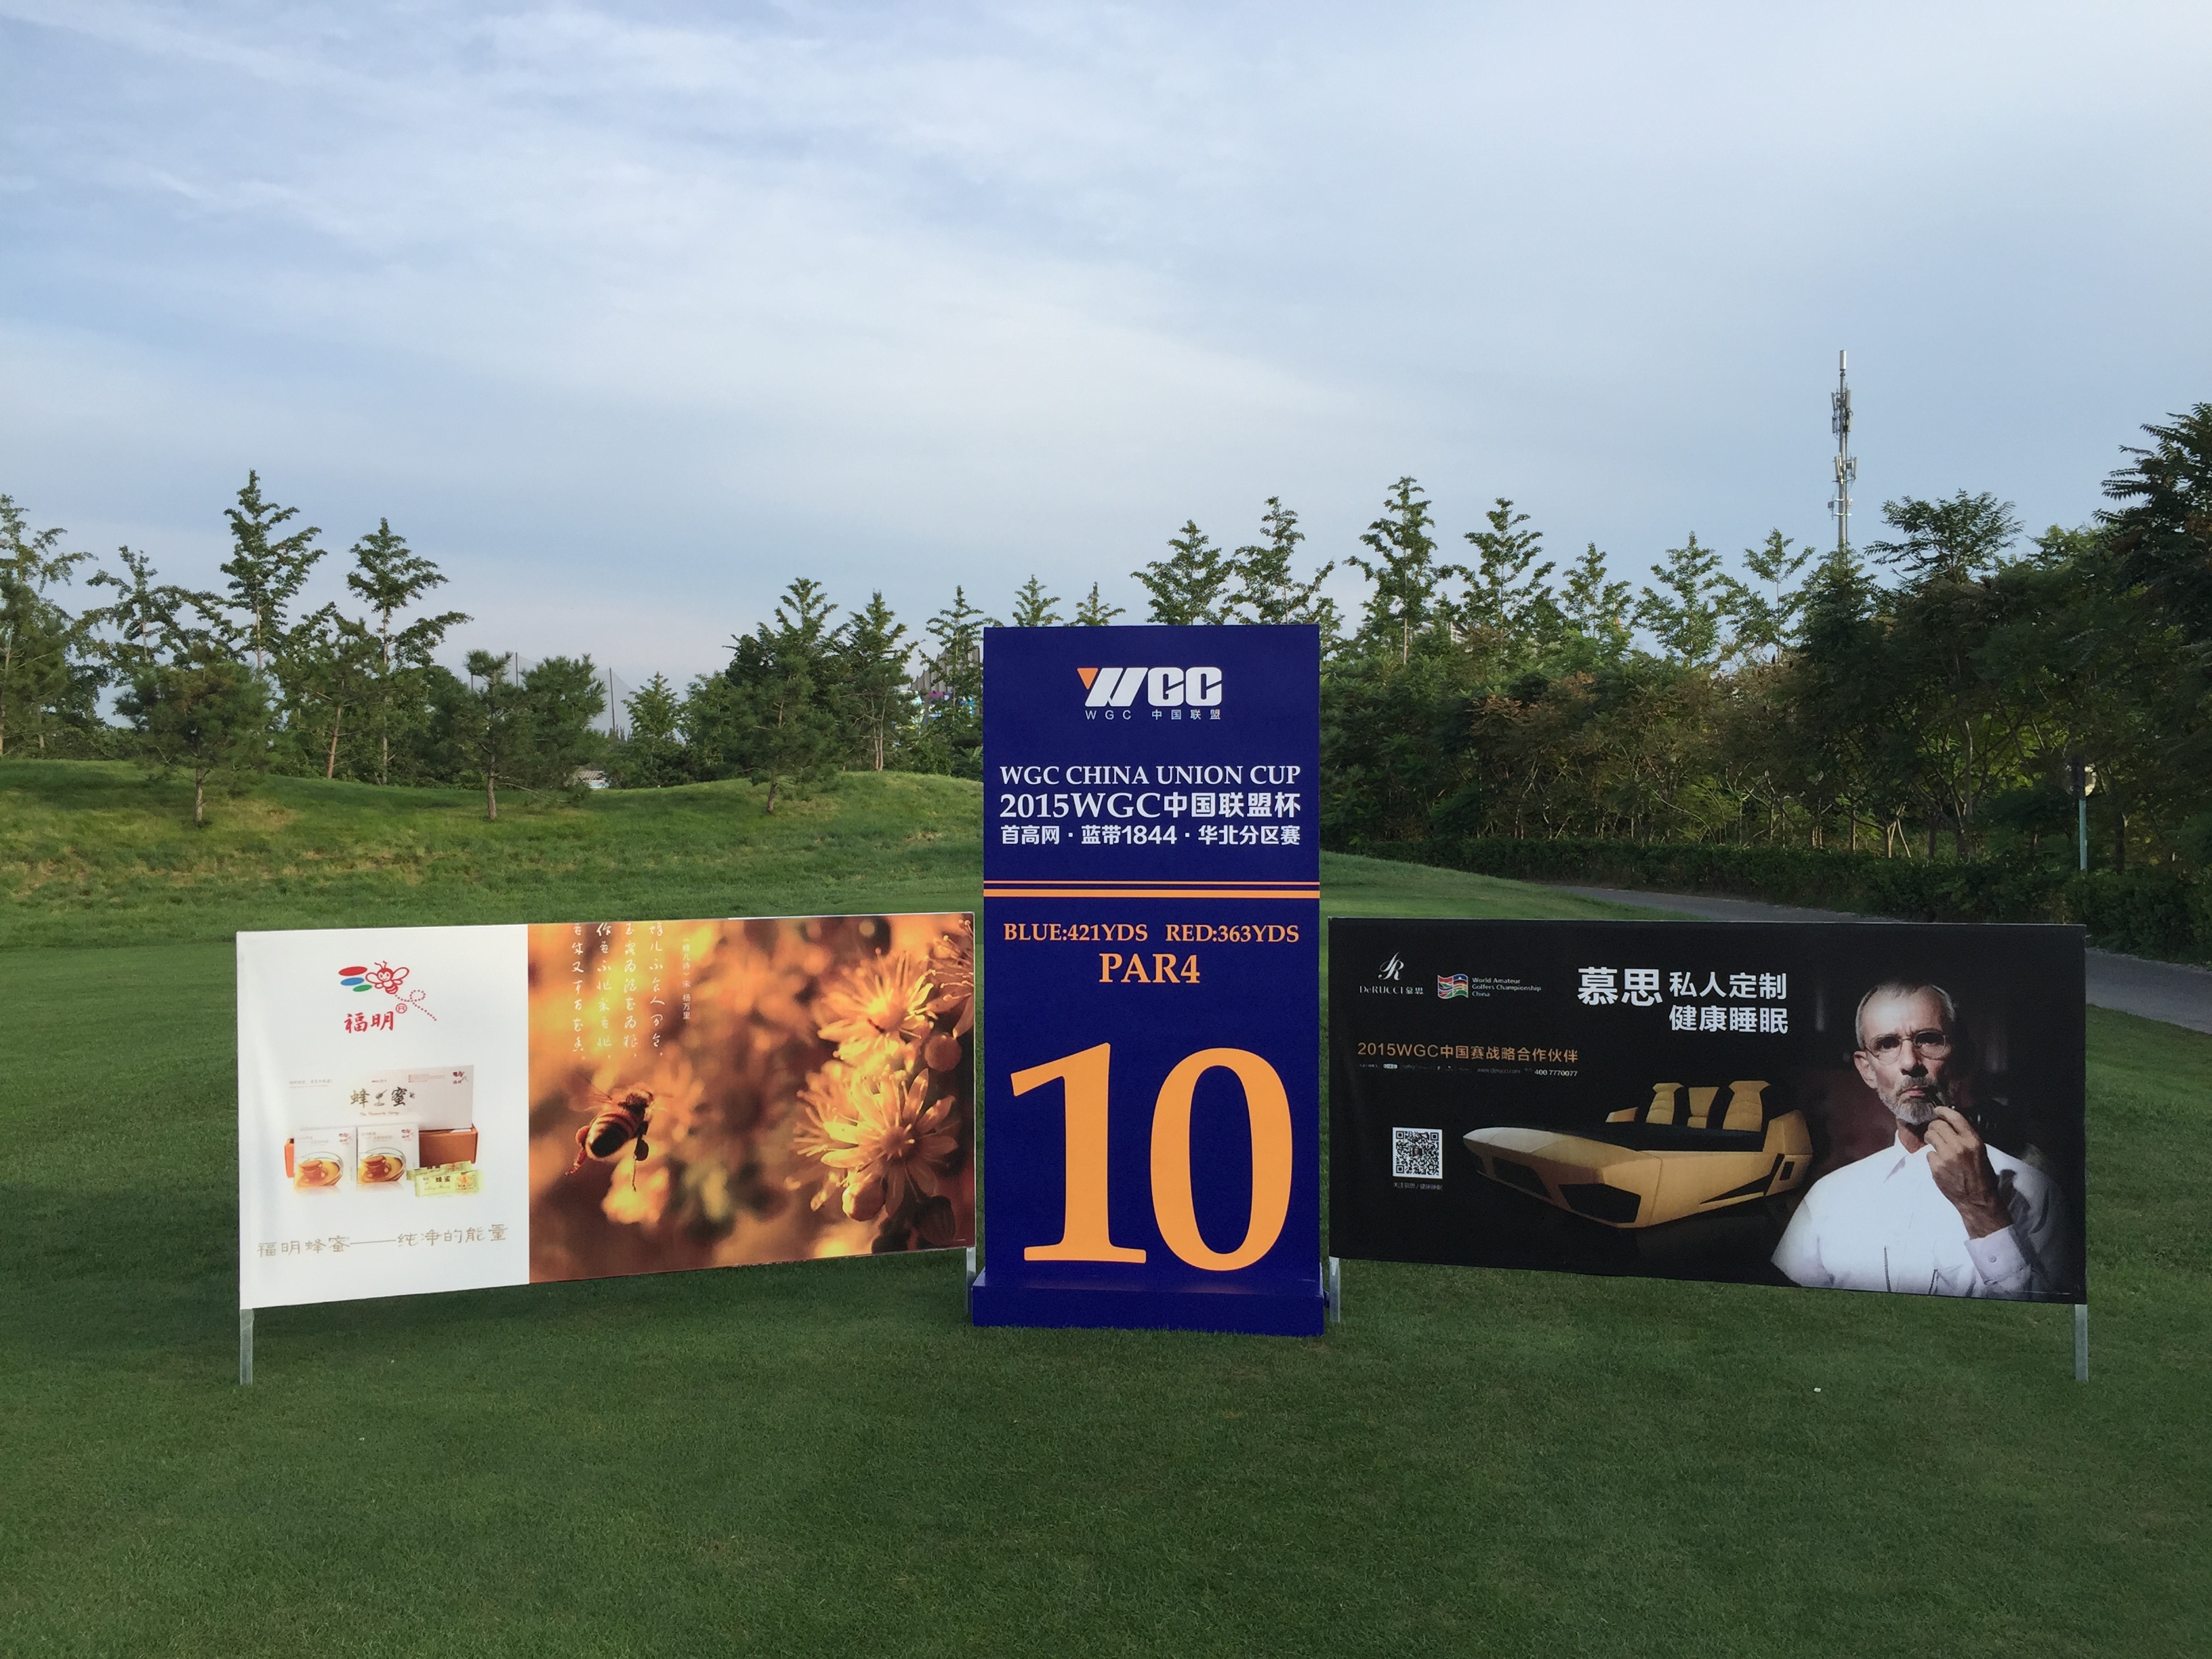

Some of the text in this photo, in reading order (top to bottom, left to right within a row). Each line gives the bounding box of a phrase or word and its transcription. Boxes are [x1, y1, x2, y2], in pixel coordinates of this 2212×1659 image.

[1085, 710, 1221, 720] WGC 中国联盟
[1000, 766, 1301, 785] WGC CHINA UNION CUP
[1000, 792, 1301, 819] 2015WGC中国联盟杯
[1004, 923, 1299, 943] BLUE:421YDS RED:363YDS
[1099, 953, 1201, 984] PAR4
[1359, 985, 1404, 994] DeRUCCI
[1496, 984, 1542, 992] Championship
[1577, 966, 1787, 1006] 慕思 私人定制
[344, 1010, 394, 1033] 福明
[1669, 1004, 1788, 1034] 健康睡眠
[1357, 1042, 1579, 1063] 2015WGC中国赛战略合作伙伴
[1010, 1042, 1293, 1271] 10
